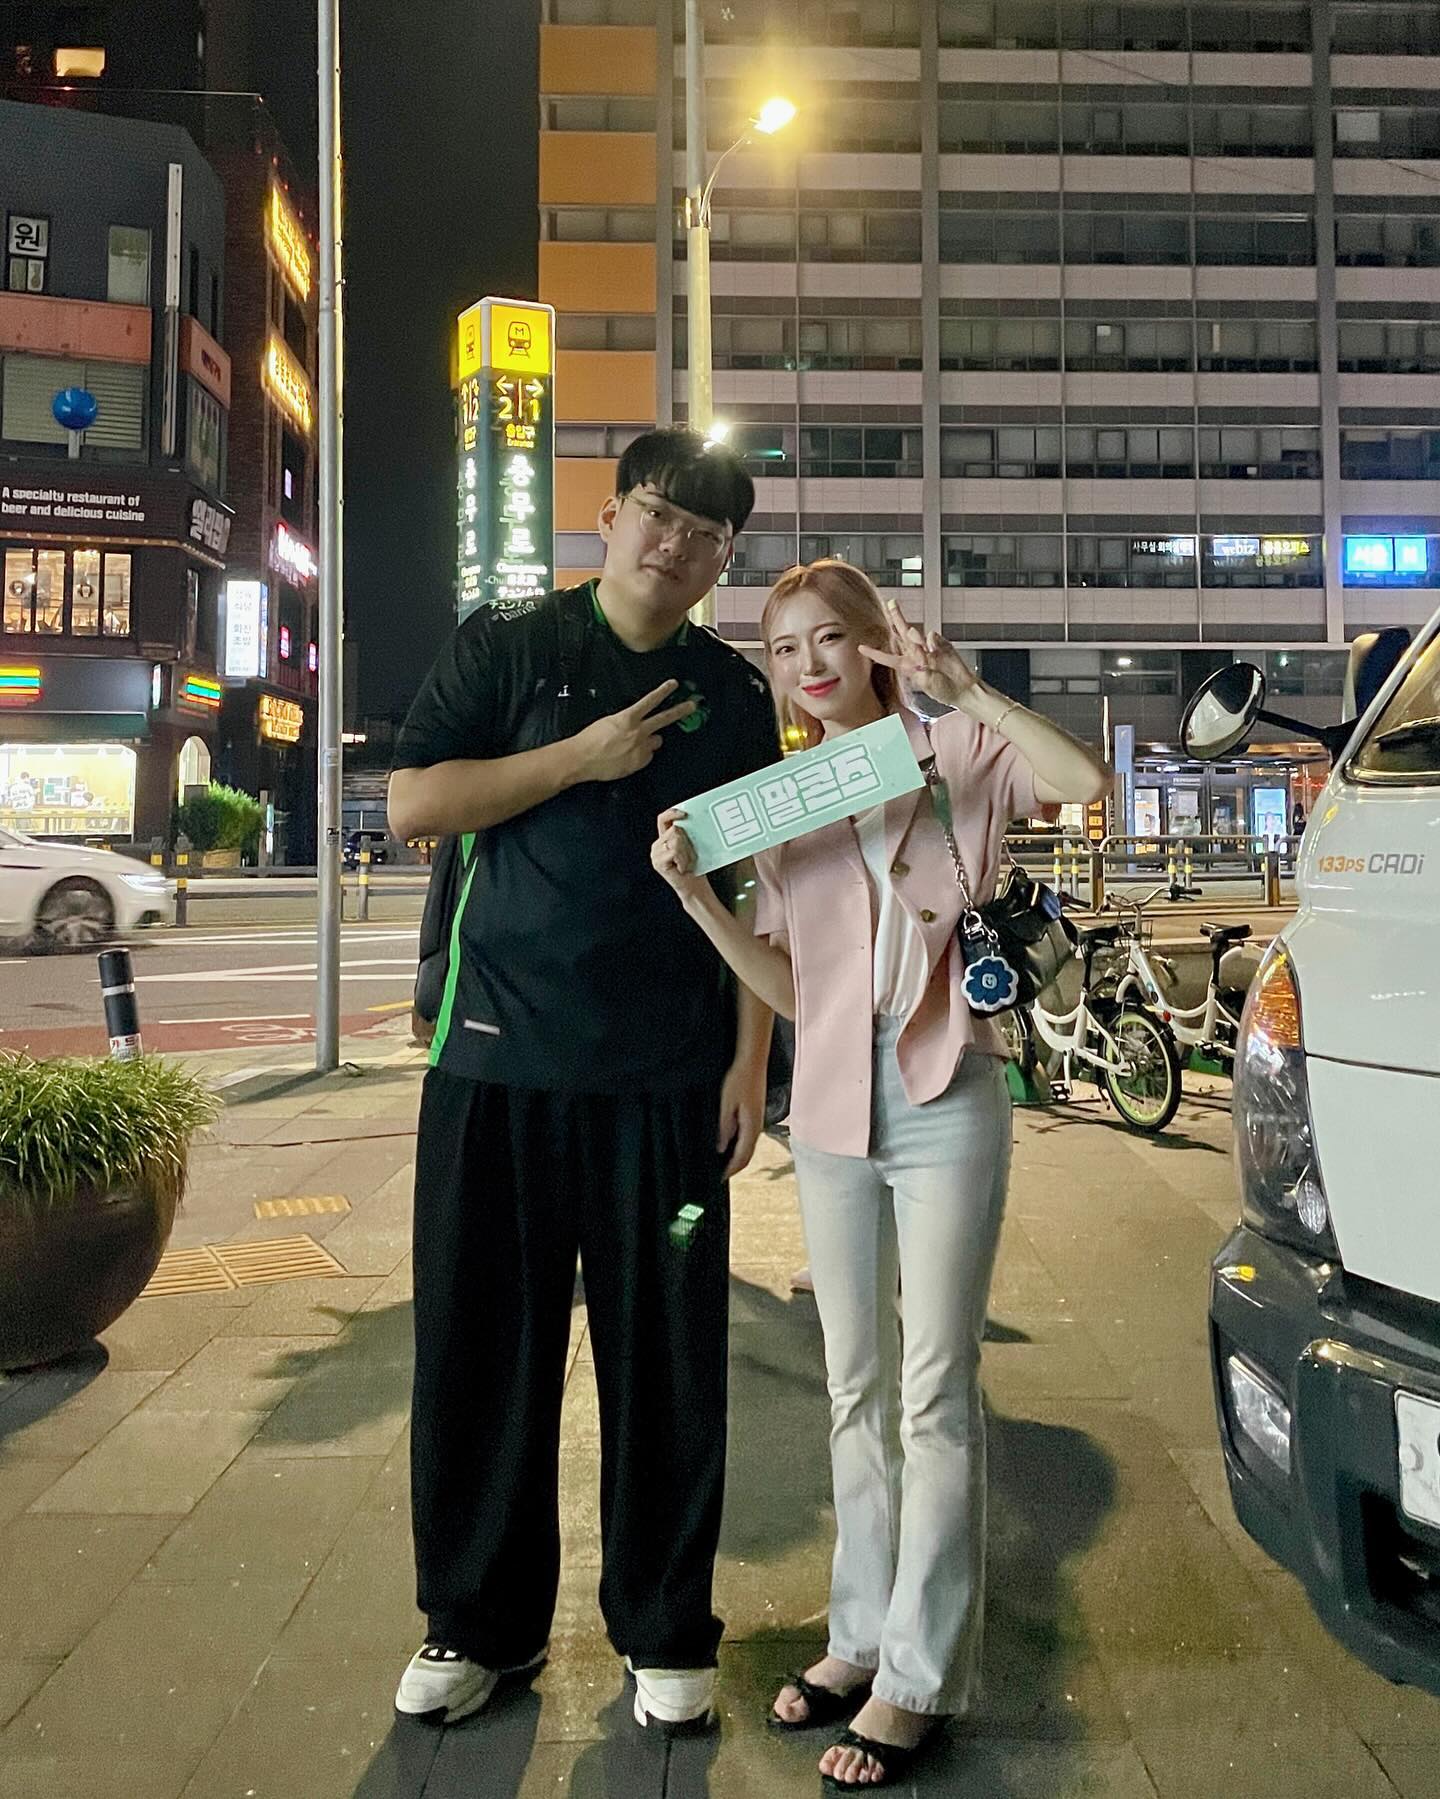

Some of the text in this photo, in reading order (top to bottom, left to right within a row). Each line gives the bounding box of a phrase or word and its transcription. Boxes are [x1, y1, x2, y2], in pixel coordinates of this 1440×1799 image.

[15, 223, 41, 252] 원
[498, 396, 540, 421] 2 1
[2, 486, 140, 507] A specialty restaurant of
[1, 502, 145, 522] beer and delicious cuisine
